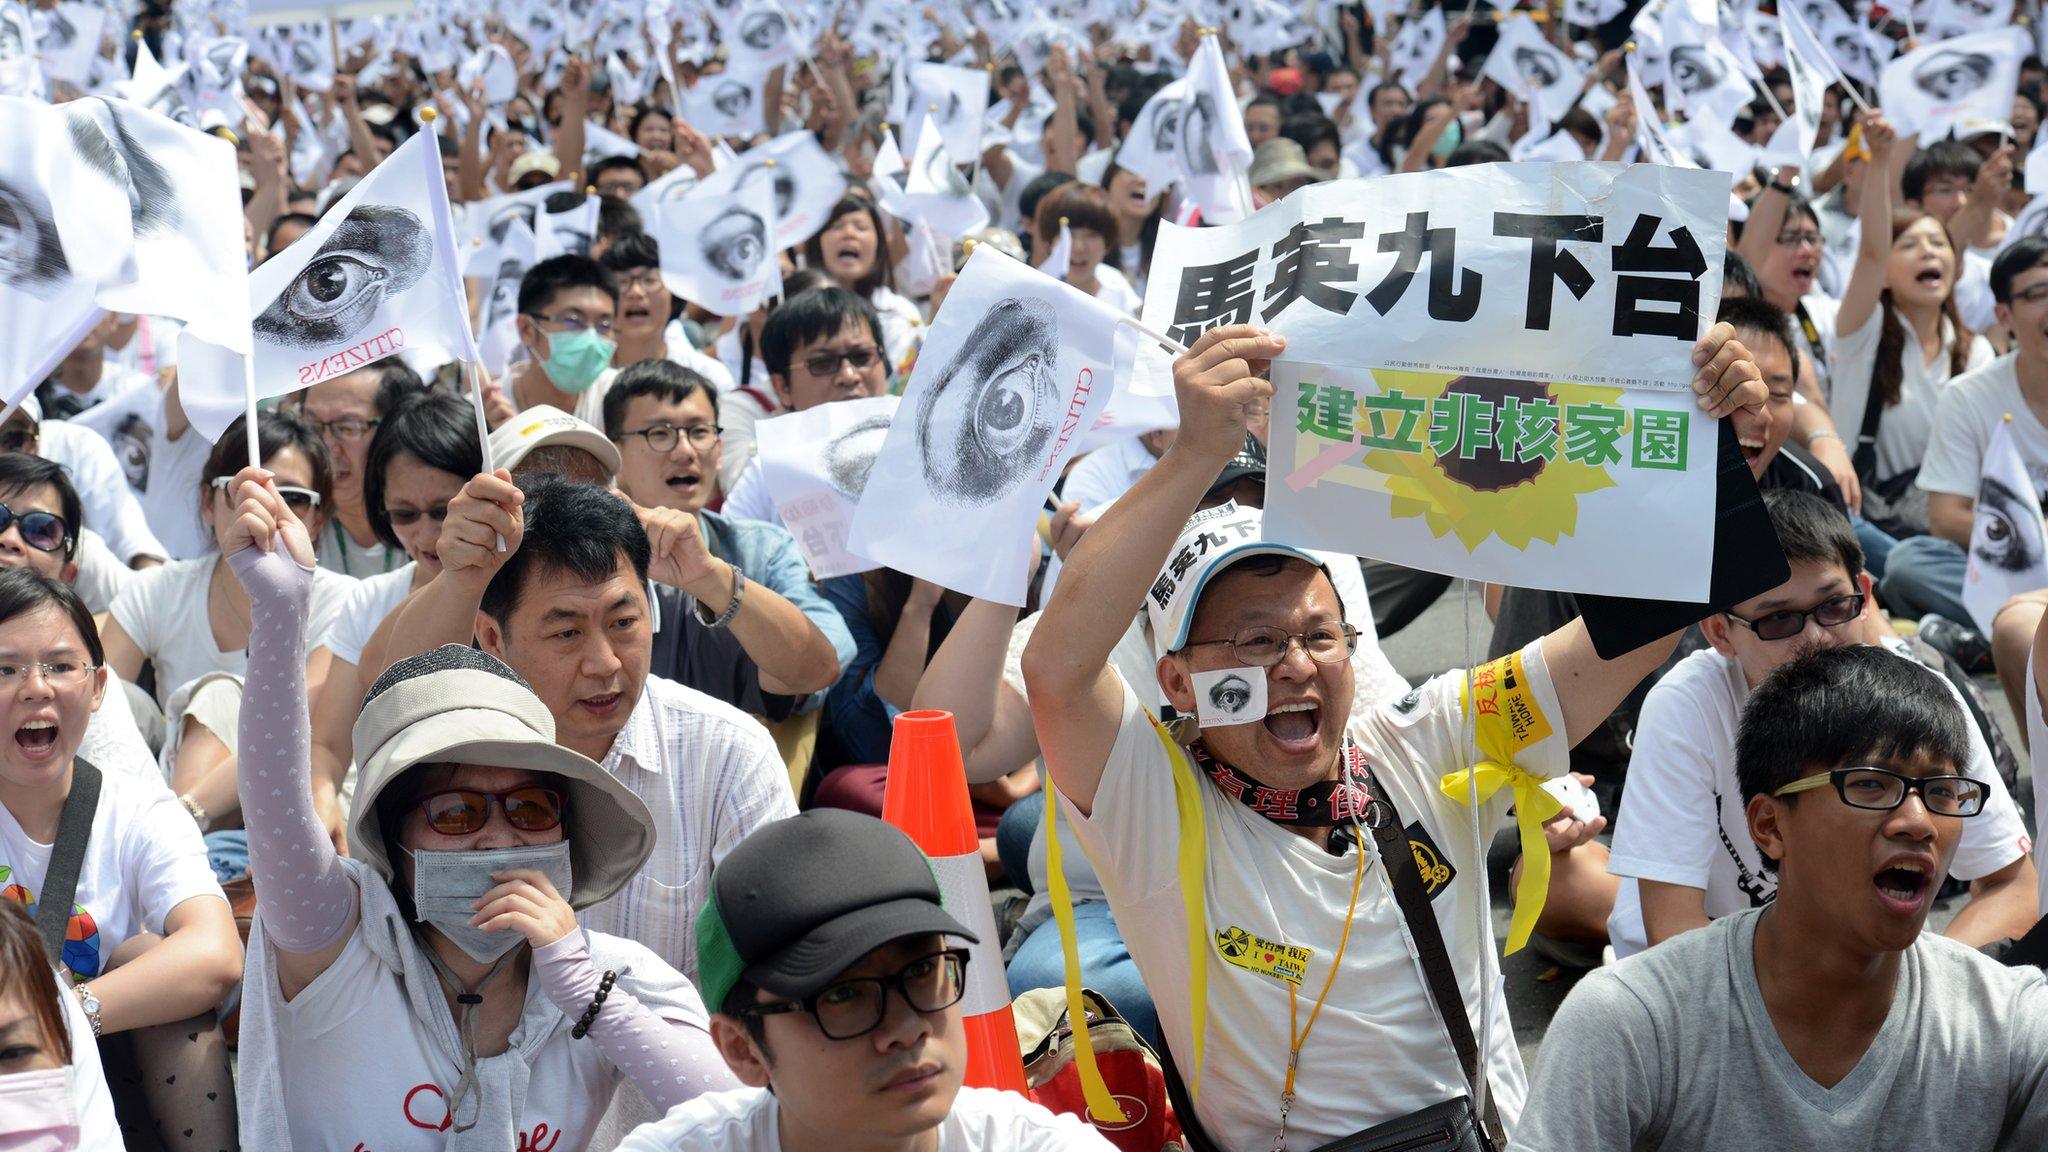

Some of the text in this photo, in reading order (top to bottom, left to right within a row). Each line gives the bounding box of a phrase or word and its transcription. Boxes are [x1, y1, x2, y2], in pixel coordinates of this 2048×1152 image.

[1159, 210, 1708, 355] 馬英九下台
[1296, 382, 1690, 472] 建立非核家園
[1150, 519, 1261, 611] 馬英九下
[1511, 693, 1535, 727] HOME
[1250, 965, 1260, 973] NO
[1253, 951, 1259, 959] I
